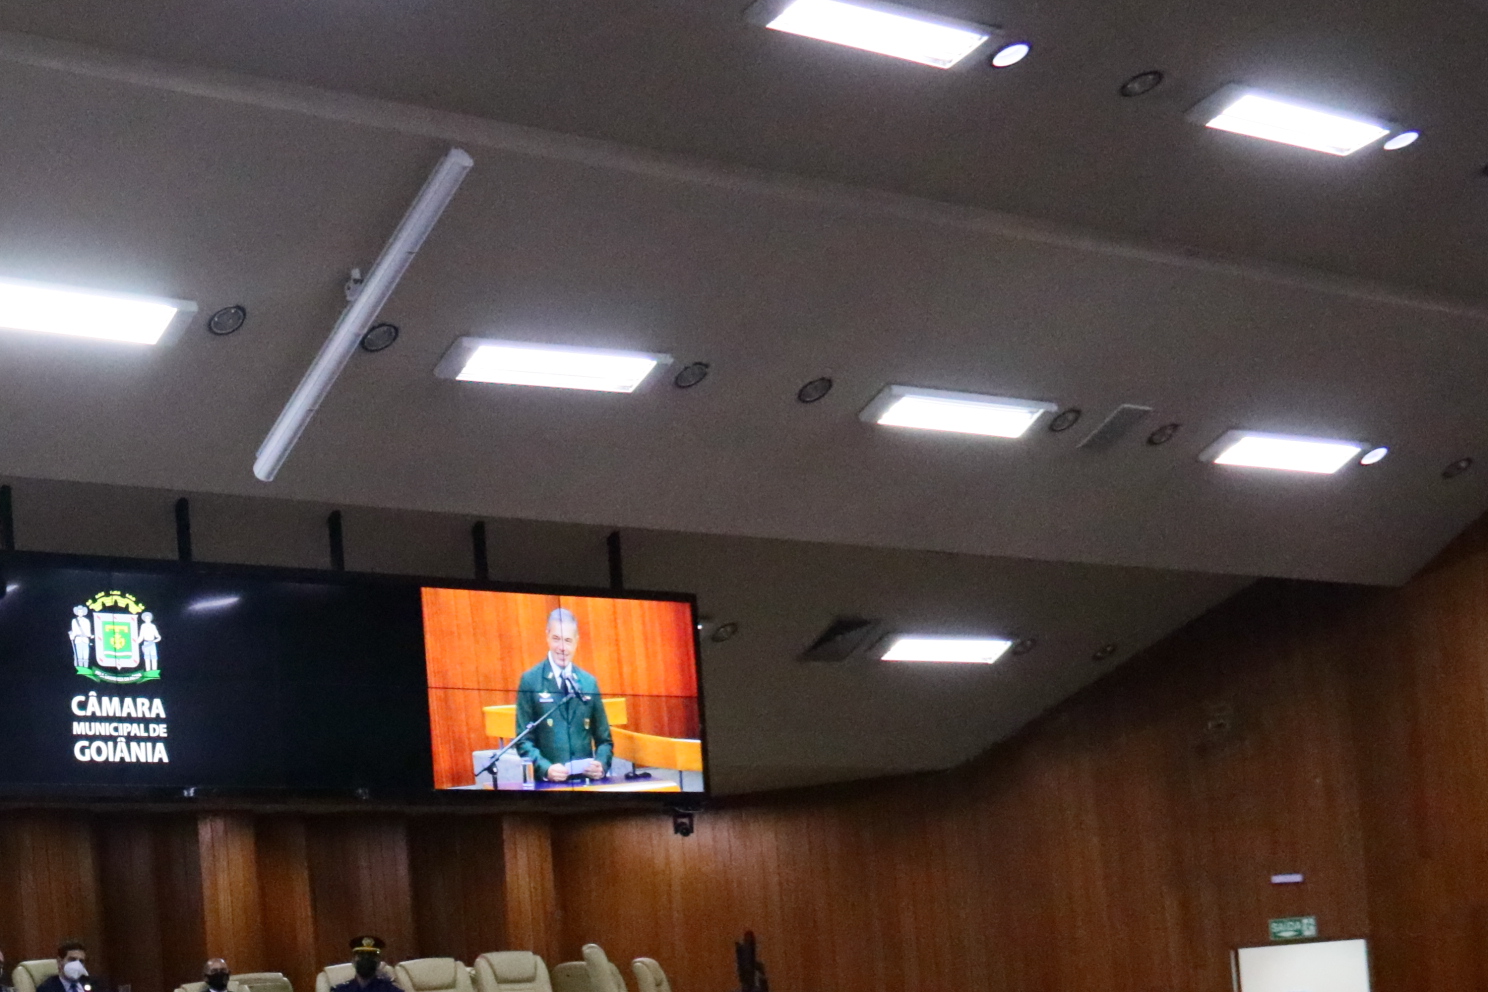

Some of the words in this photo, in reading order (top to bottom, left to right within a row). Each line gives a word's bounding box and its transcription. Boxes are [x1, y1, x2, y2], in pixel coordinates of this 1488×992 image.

[71, 691, 166, 718] CÂMARA
[73, 721, 148, 736] MUNICIPAL
[149, 723, 168, 737] DE
[74, 737, 169, 762] GOIÂNIA
